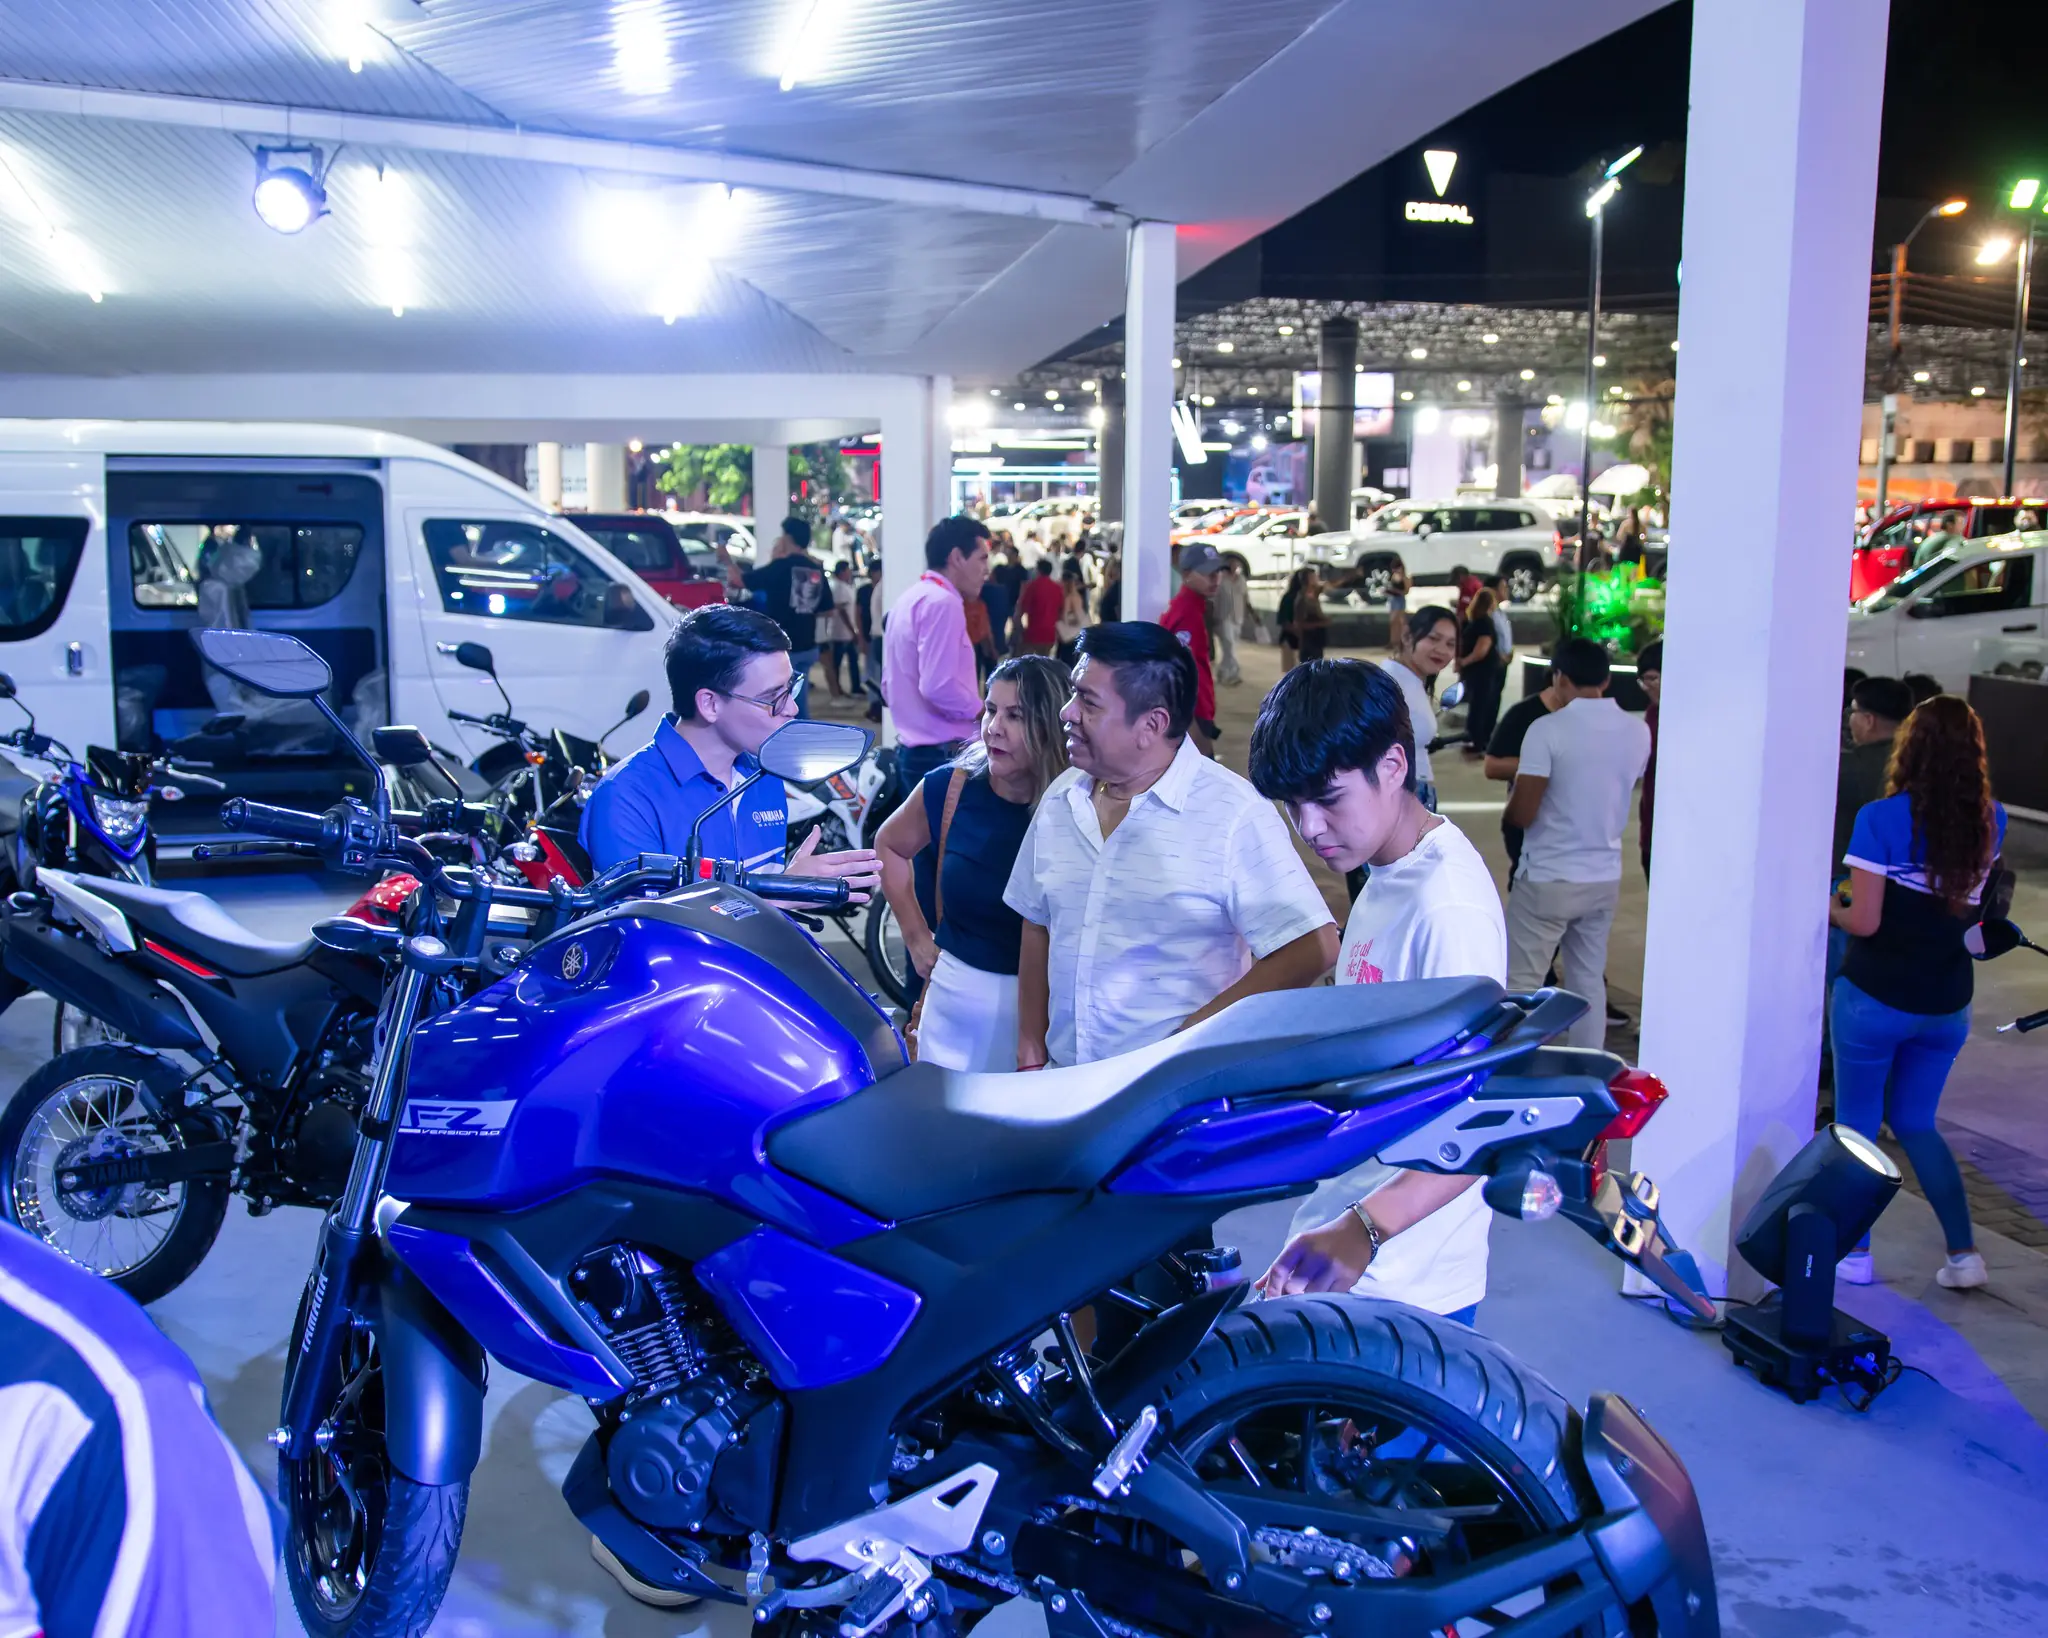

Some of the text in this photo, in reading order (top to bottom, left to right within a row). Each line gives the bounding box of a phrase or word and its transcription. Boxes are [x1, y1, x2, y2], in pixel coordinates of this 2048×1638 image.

[408, 1103, 488, 1130] FZ
[88, 1159, 152, 1185] YAMAHA
[302, 1272, 329, 1353] YAMAHA
